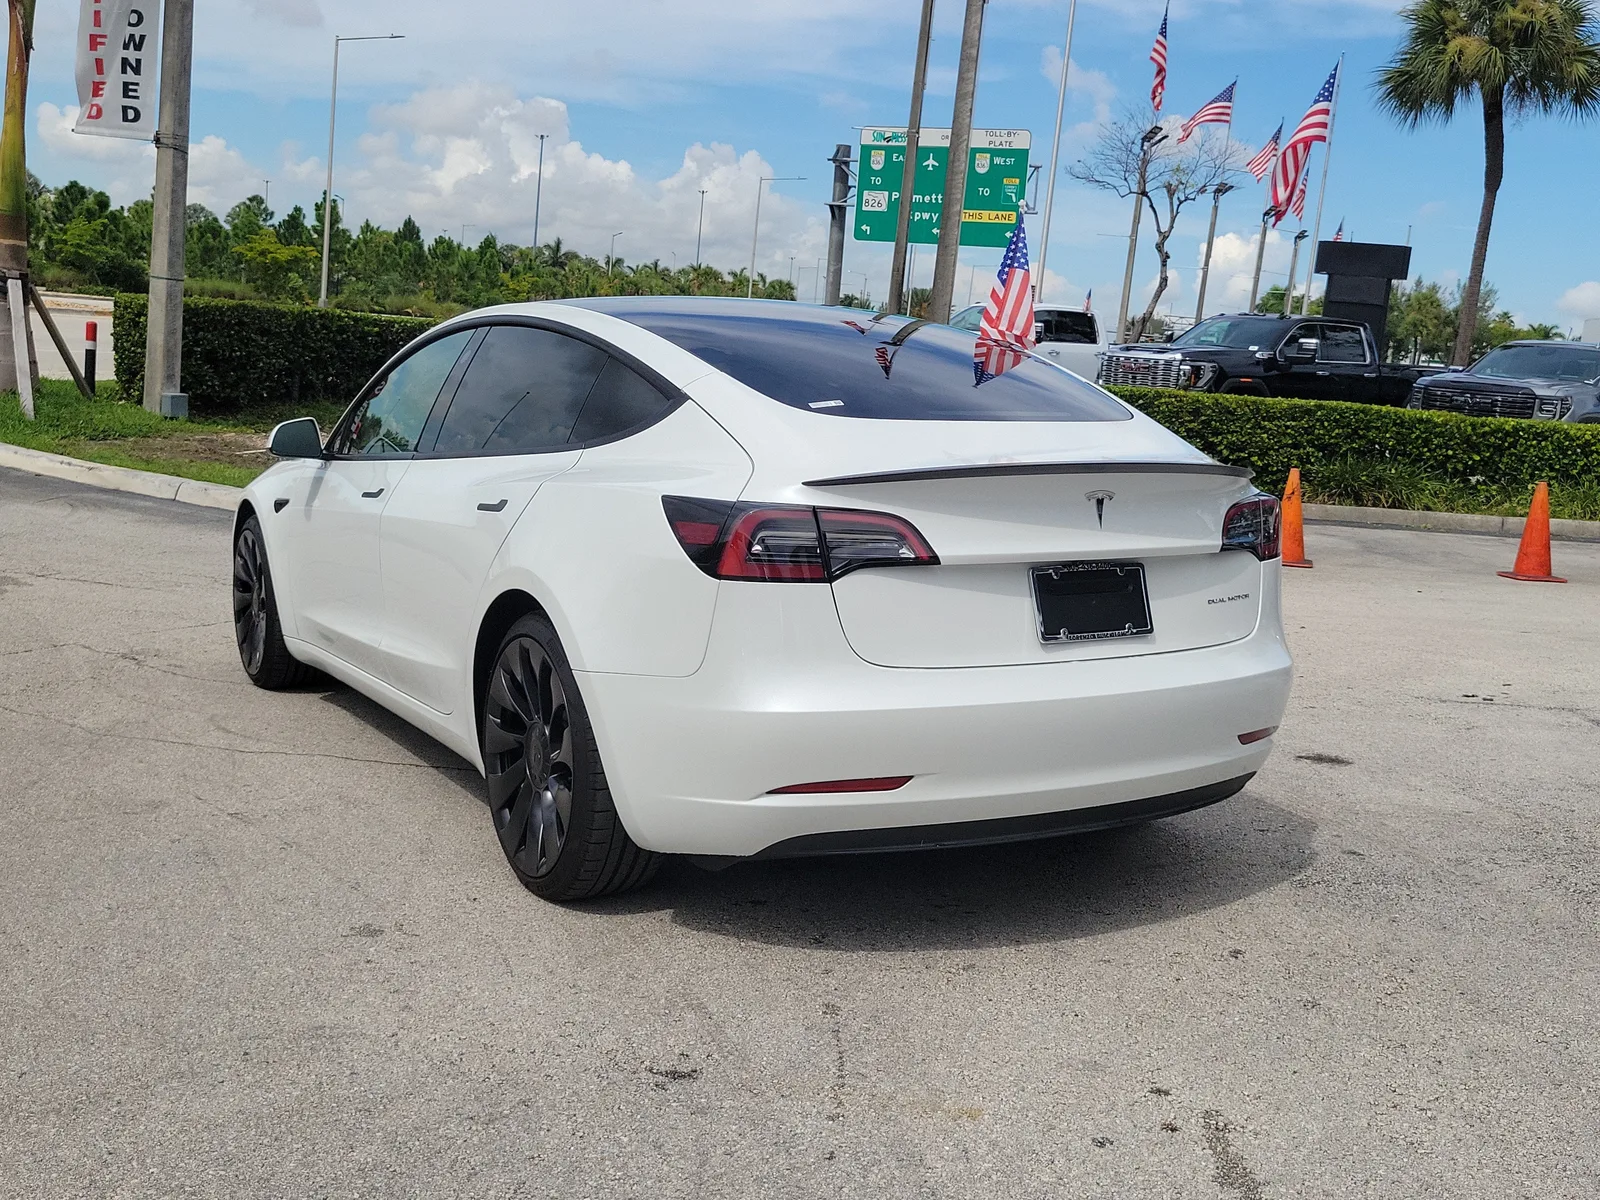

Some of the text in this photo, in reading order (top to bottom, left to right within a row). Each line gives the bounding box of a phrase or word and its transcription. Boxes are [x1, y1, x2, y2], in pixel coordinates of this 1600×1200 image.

[87, 0, 108, 120] IFIED
[121, 9, 147, 123] OWNED
[988, 140, 1014, 148] PLATE
[993, 156, 1016, 165] WEST
[870, 176, 882, 185] TO
[977, 187, 990, 196] TO
[864, 198, 883, 208] 826
[963, 211, 1014, 221] THIS LANE
